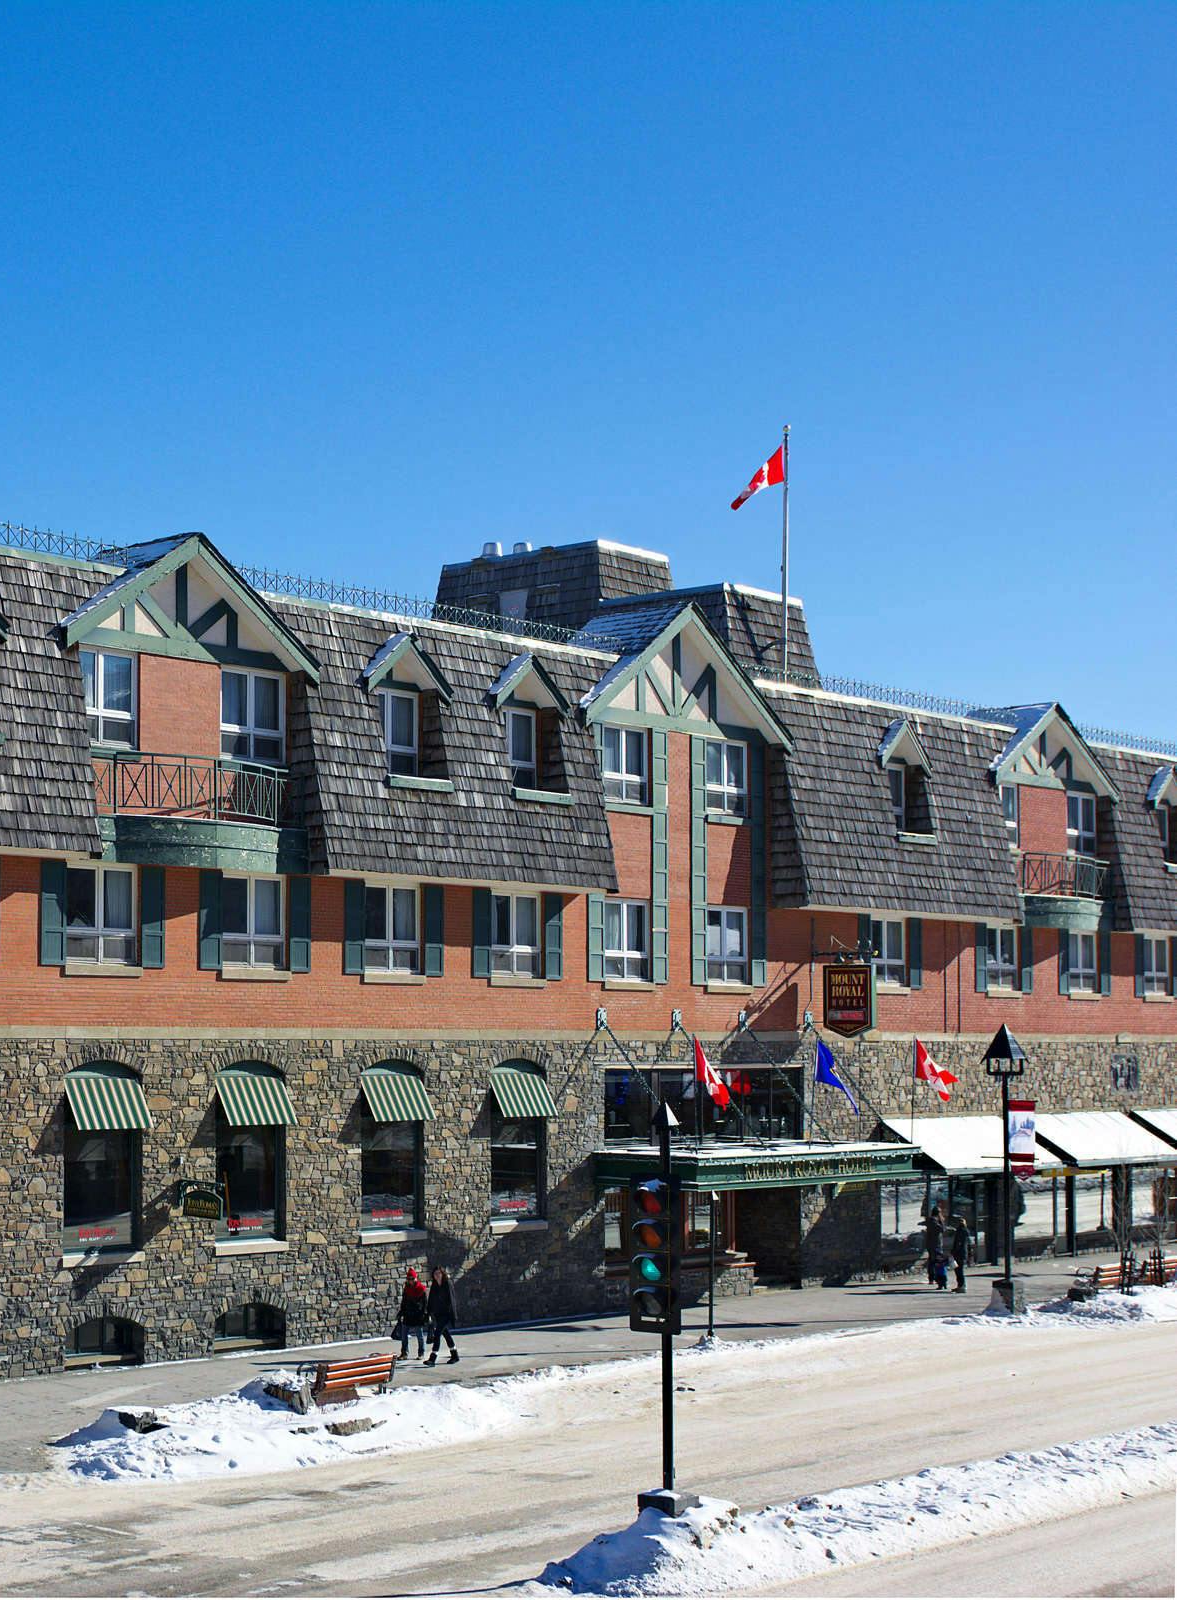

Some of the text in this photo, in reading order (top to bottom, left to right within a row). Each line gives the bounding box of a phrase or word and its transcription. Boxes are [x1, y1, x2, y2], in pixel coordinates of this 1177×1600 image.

[831, 974, 865, 985] MOUNT
[832, 986, 865, 997] ROYAL
[832, 998, 865, 1007] HOTEL
[745, 1157, 873, 1181] MOUNT ROYAL HOTEL
